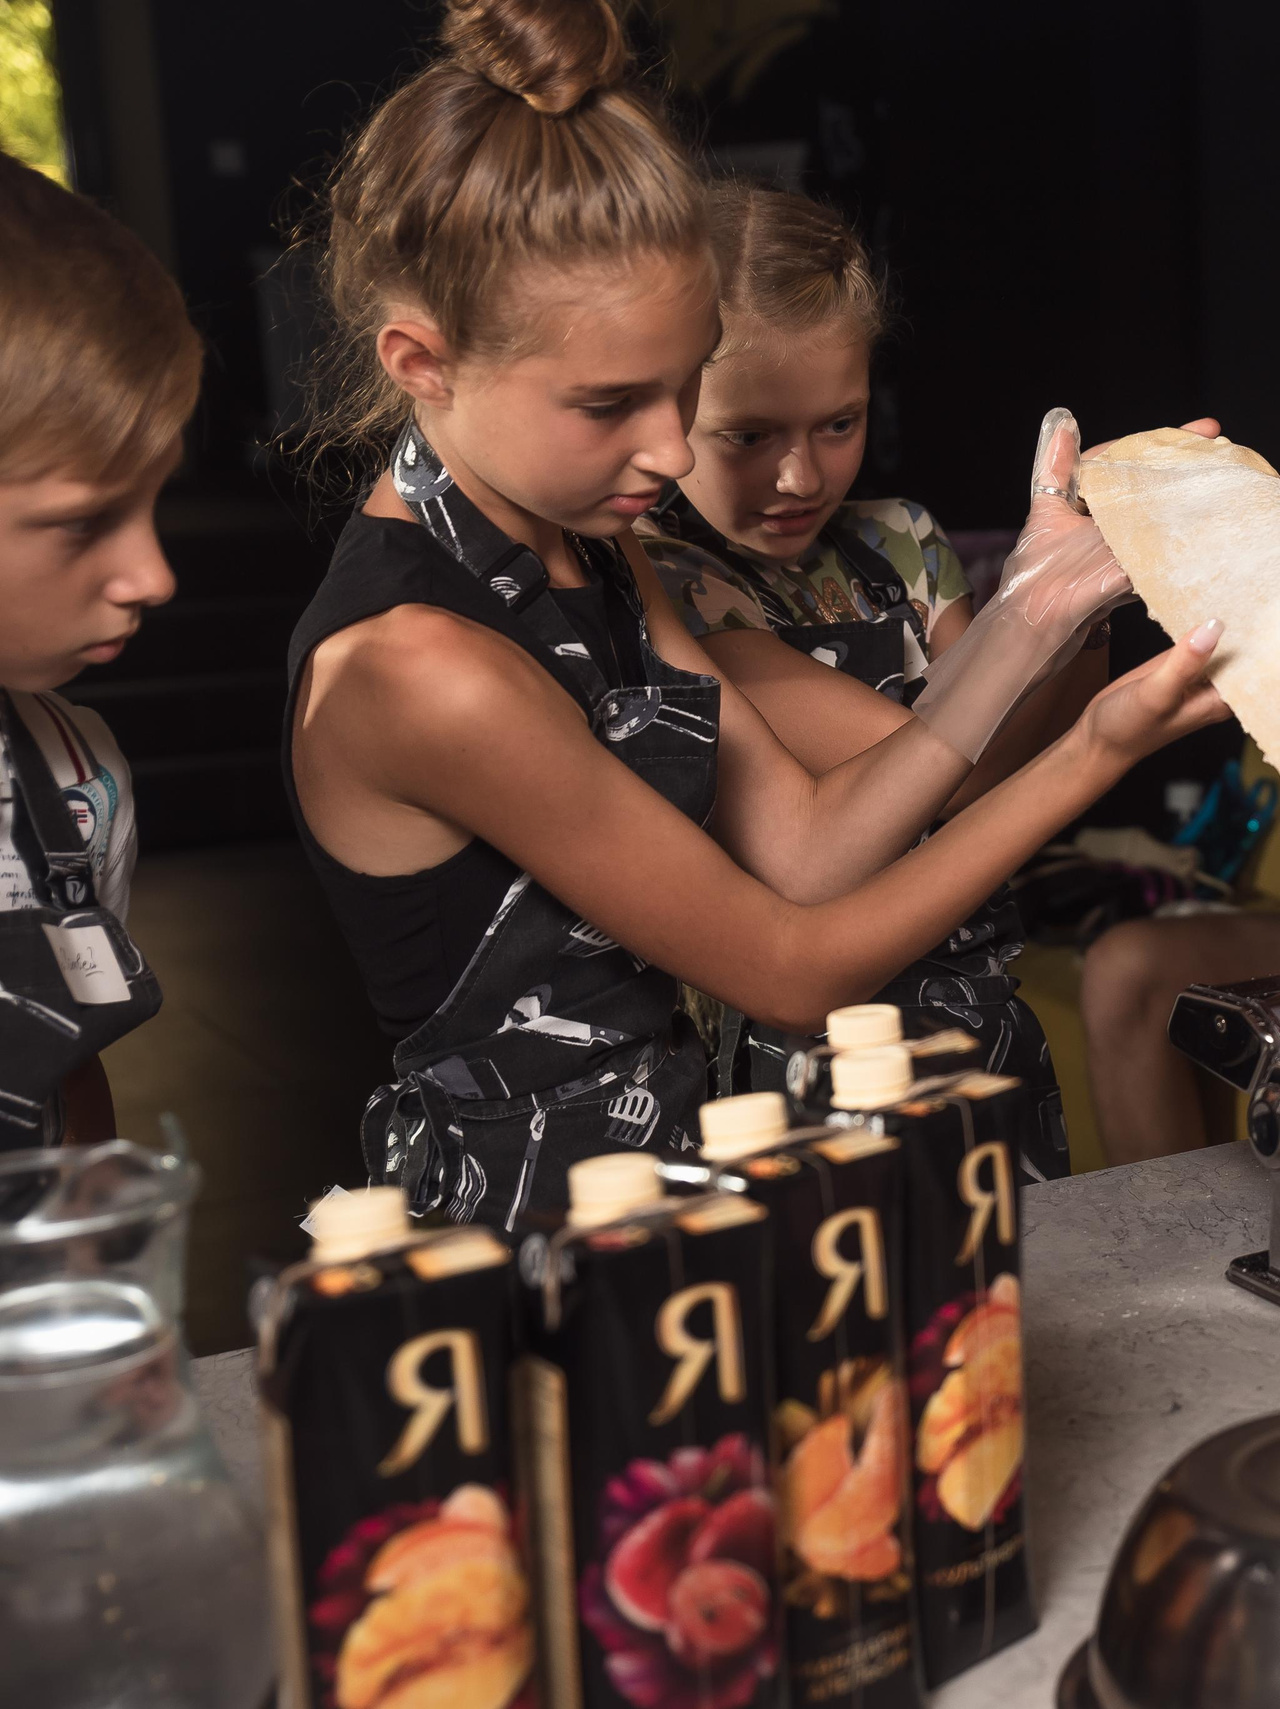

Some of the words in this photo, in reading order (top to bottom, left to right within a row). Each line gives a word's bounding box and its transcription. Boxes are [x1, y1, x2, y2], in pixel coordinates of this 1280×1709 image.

[807, 1206, 889, 1341] Я
[954, 1141, 1016, 1266] Я
[376, 1328, 490, 1478] Я
[649, 1281, 747, 1426] Я
